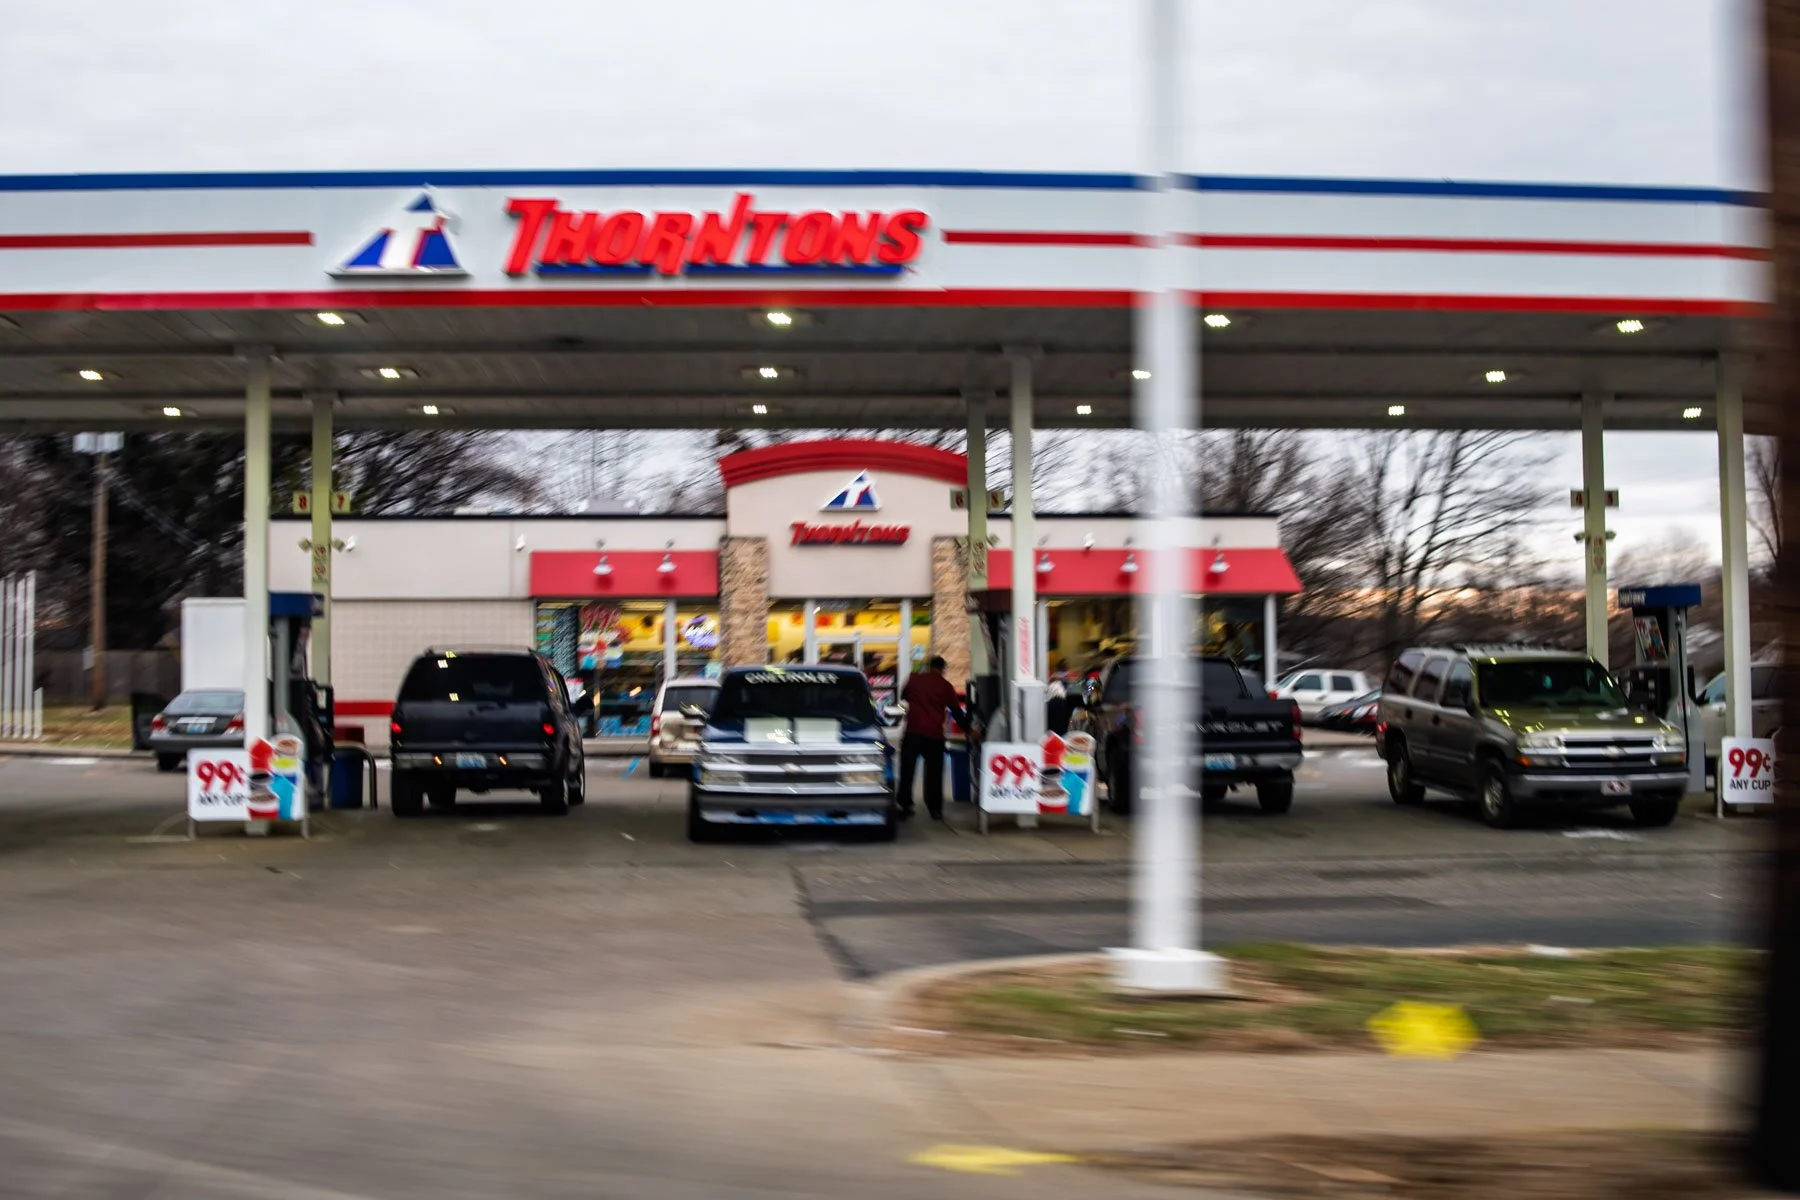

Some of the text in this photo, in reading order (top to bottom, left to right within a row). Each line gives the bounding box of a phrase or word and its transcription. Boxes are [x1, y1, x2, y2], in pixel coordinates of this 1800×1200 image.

[504, 193, 928, 276] THORNTONS
[1728, 747, 1771, 778] 99¢
[1730, 779, 1771, 790] ANY CUP
